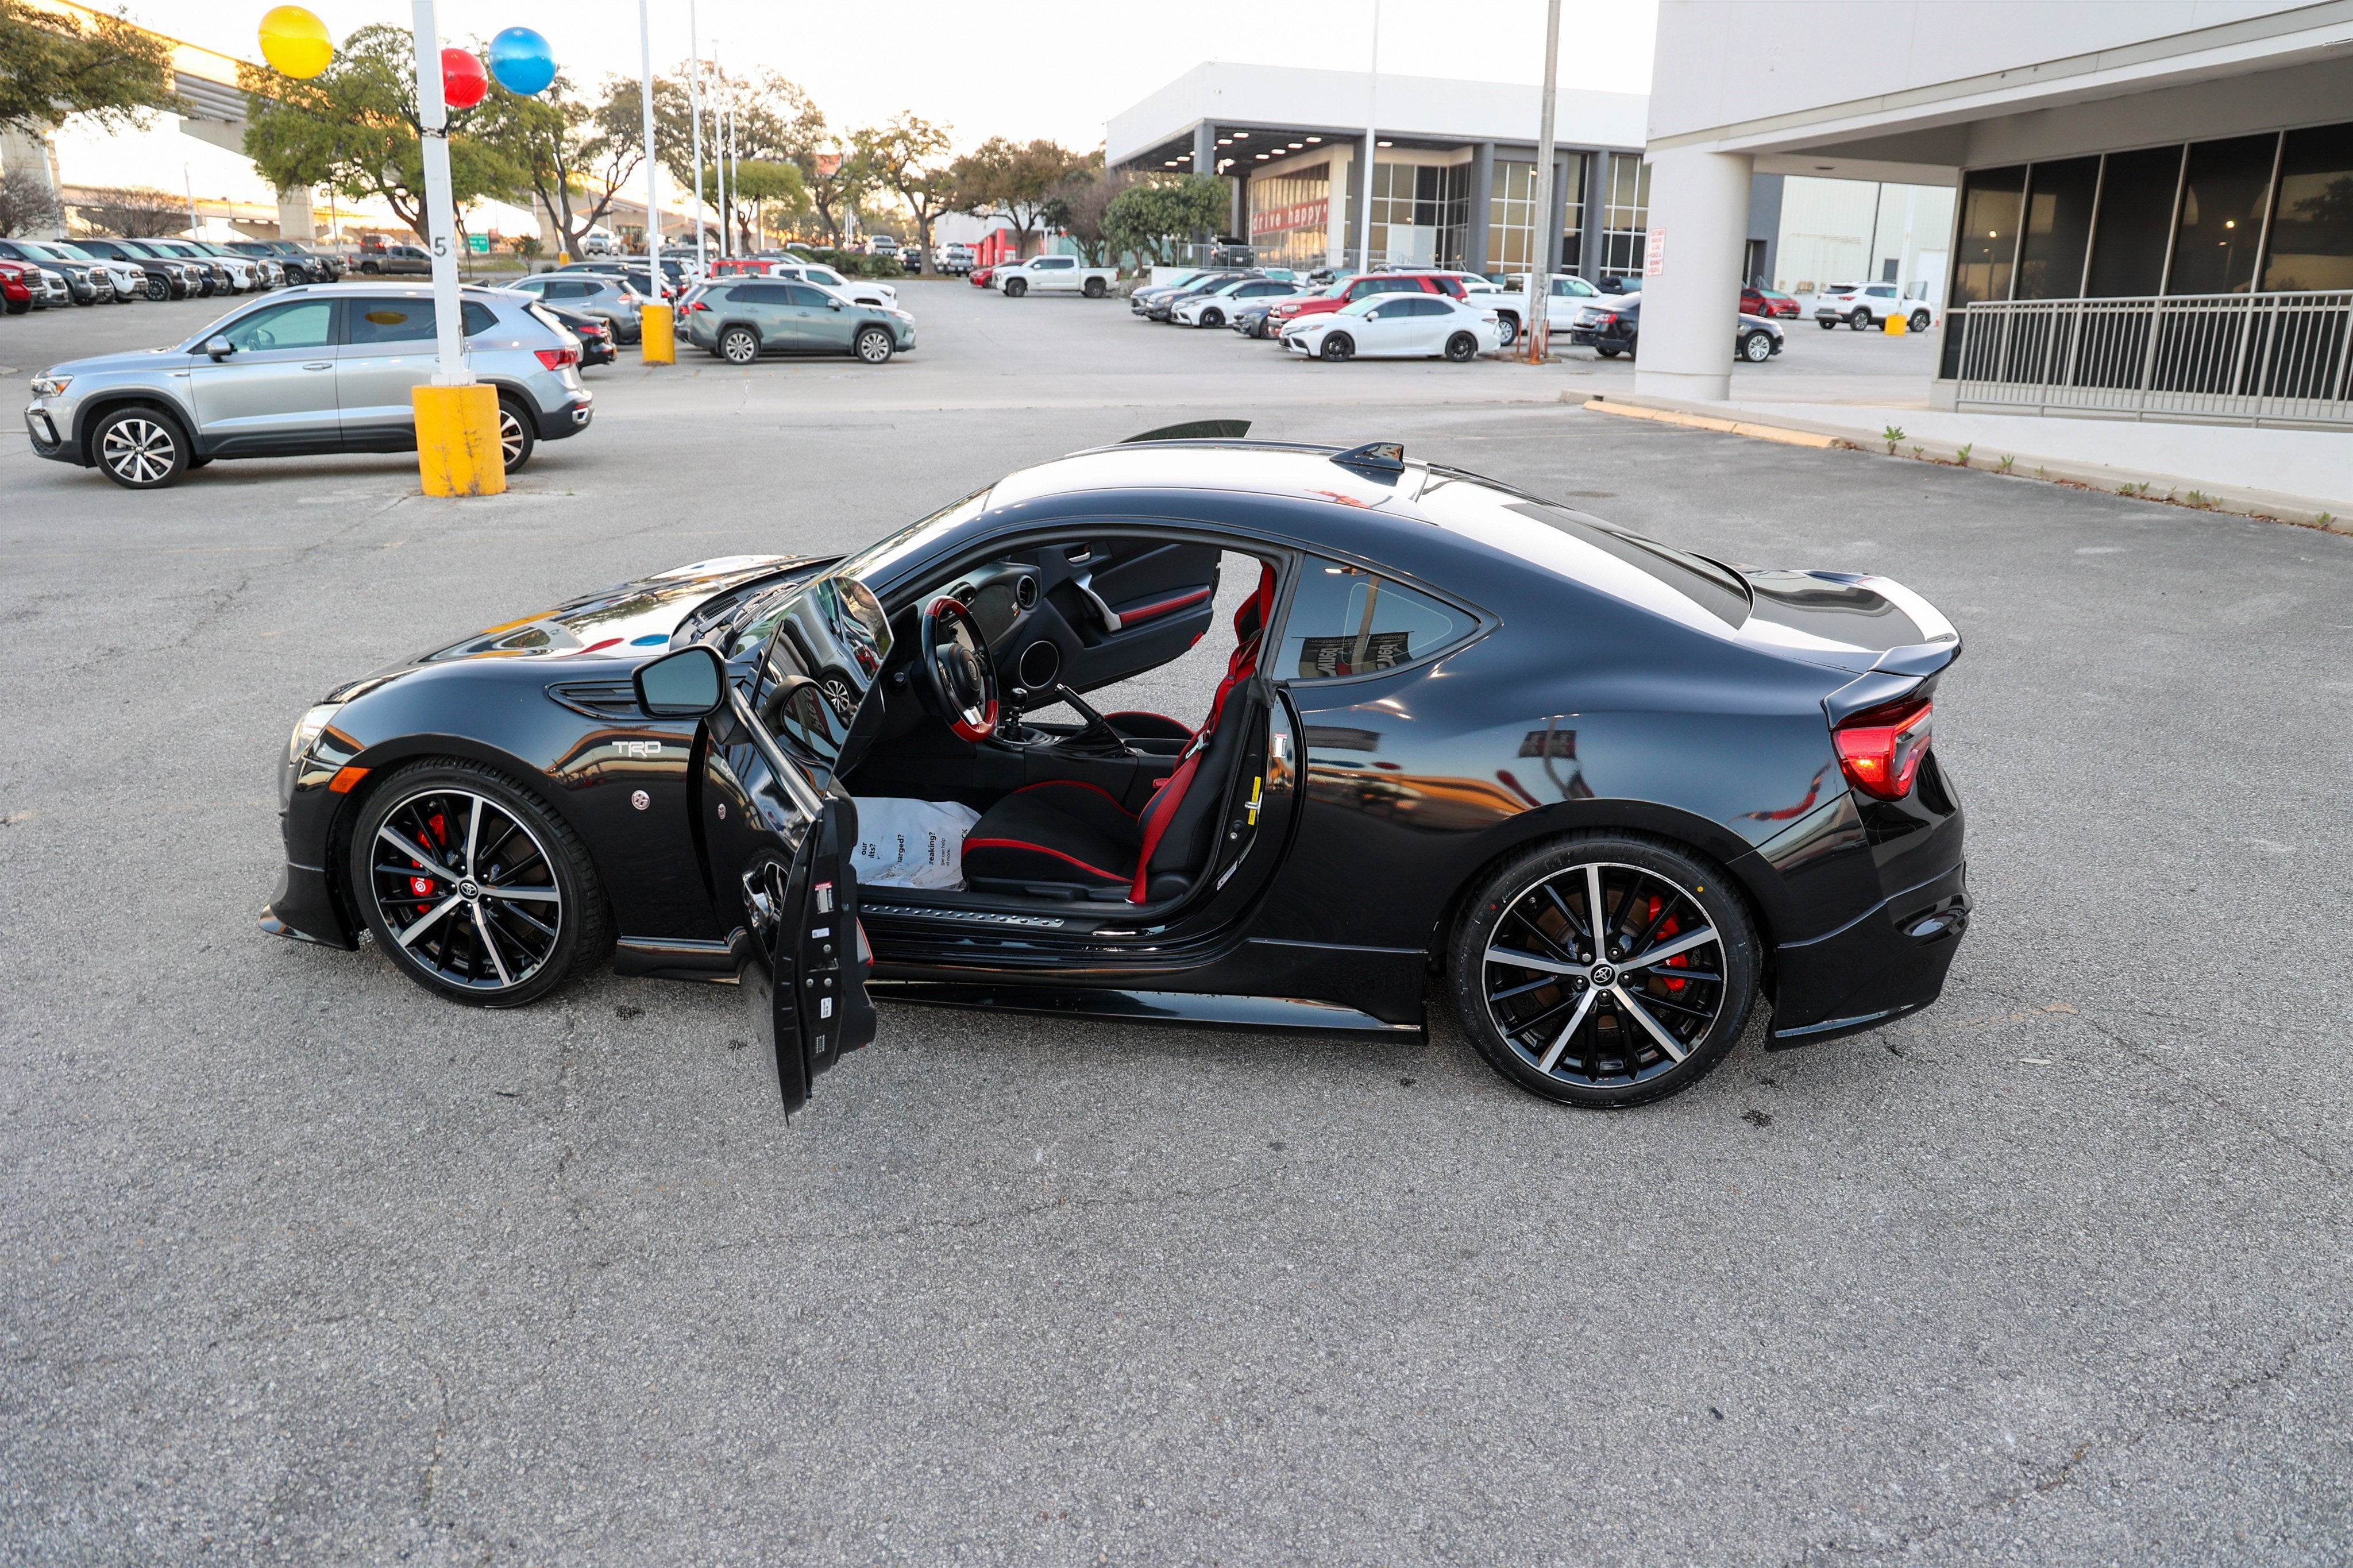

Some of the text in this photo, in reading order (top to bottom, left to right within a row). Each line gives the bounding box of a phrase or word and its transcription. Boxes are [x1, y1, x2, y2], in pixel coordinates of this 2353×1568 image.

[1252, 204, 1321, 230] drive happy
[434, 236, 447, 257] 5
[612, 741, 661, 757] TRD
[928, 831, 936, 866] reaking?
